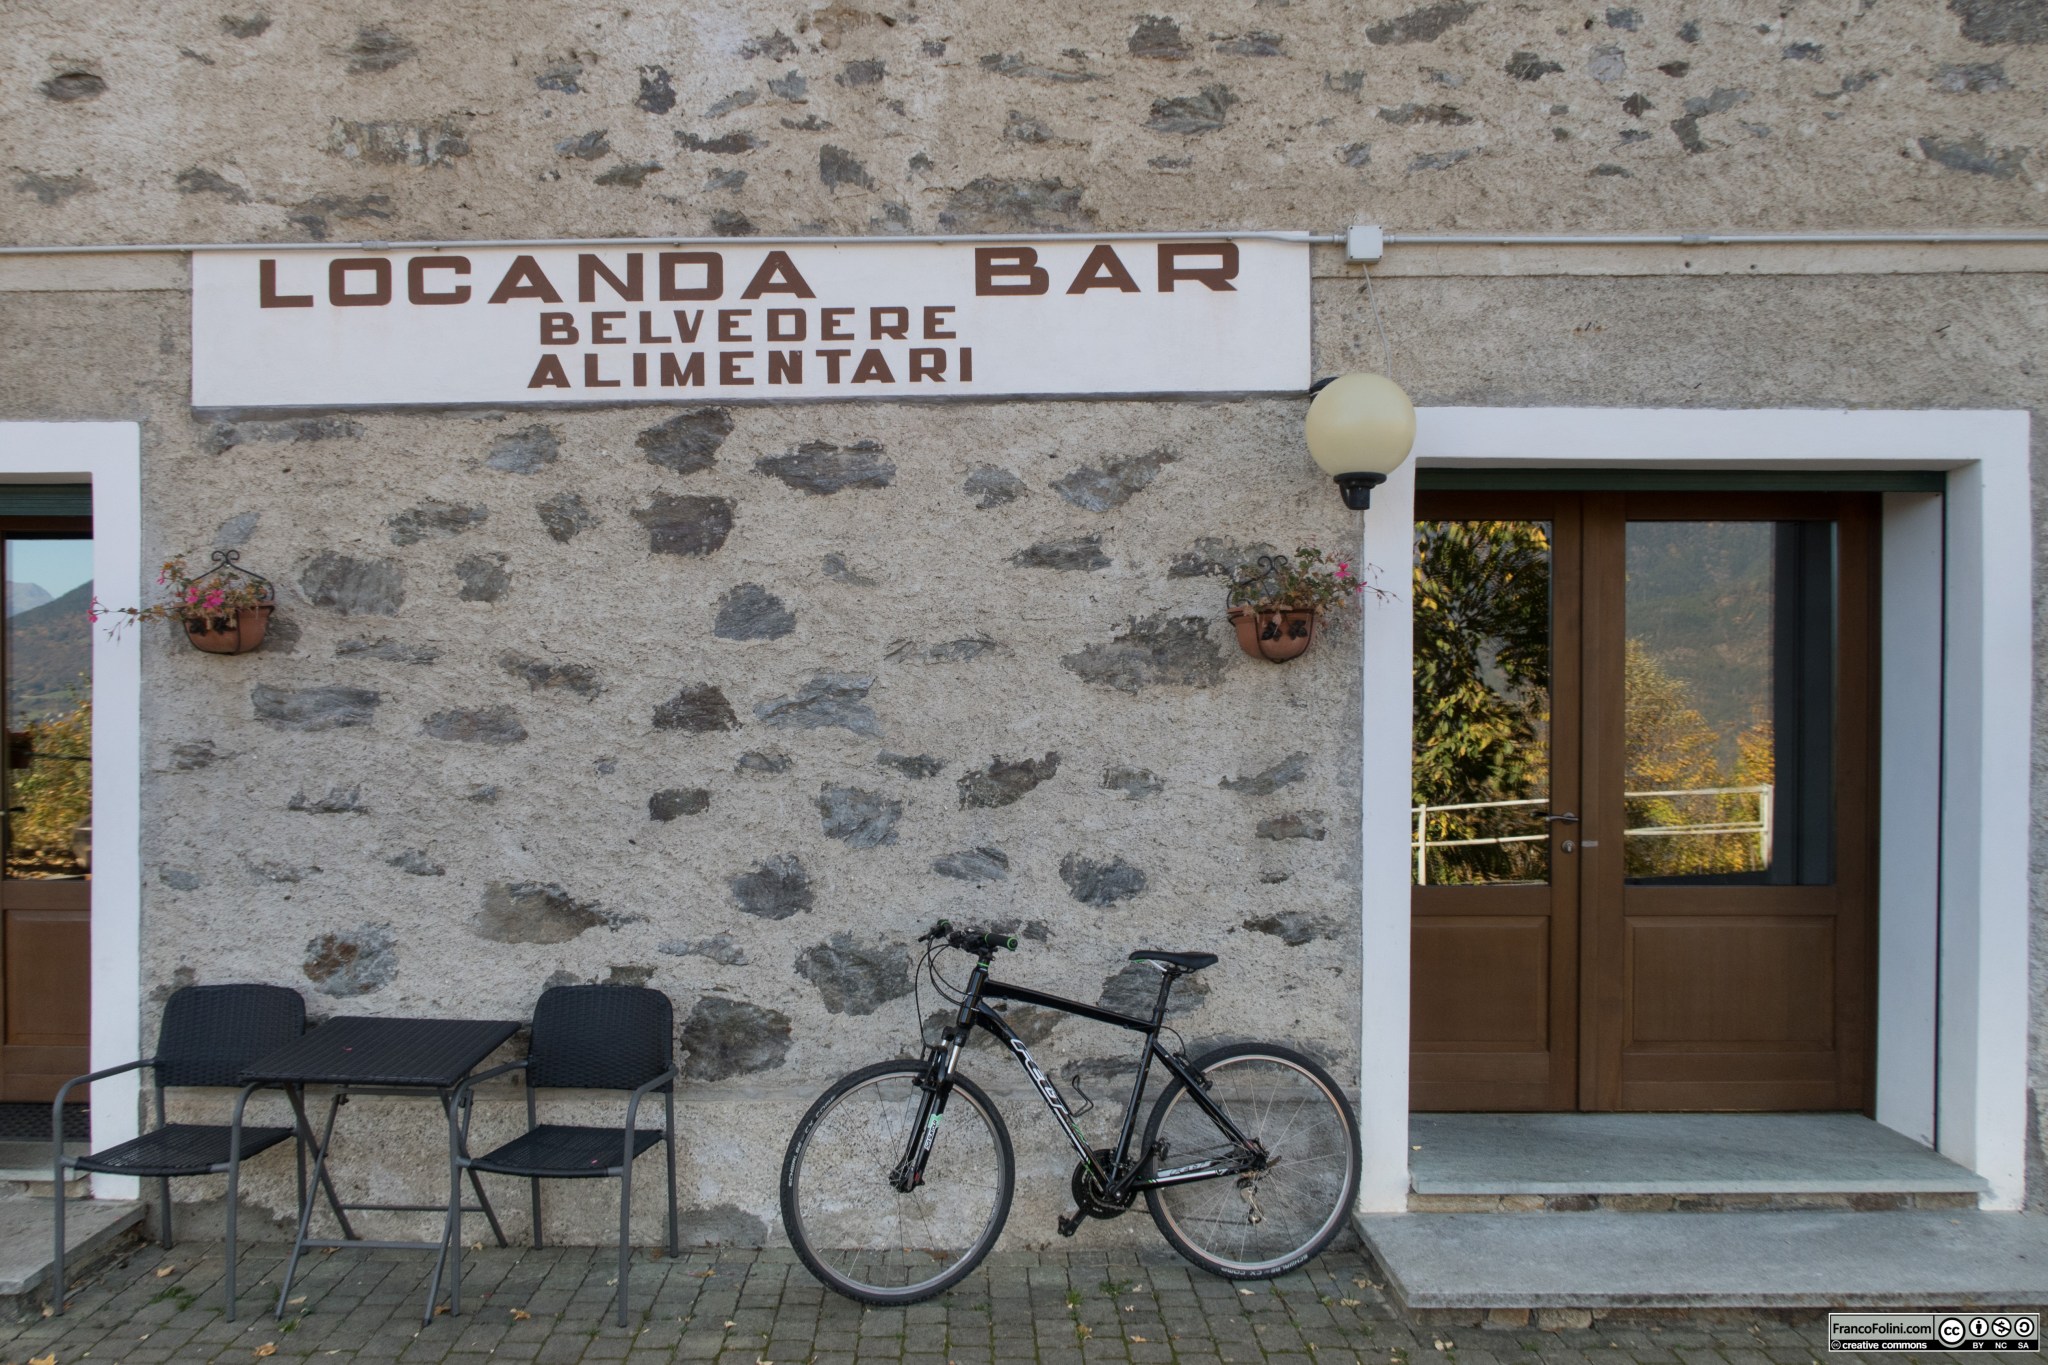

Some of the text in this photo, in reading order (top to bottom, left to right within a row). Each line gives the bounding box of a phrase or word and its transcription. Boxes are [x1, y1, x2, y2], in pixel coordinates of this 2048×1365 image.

[259, 242, 1241, 309] LOCANDA BAR
[540, 307, 956, 346] BELVEDERE
[528, 348, 972, 389] ALIMENTARI
